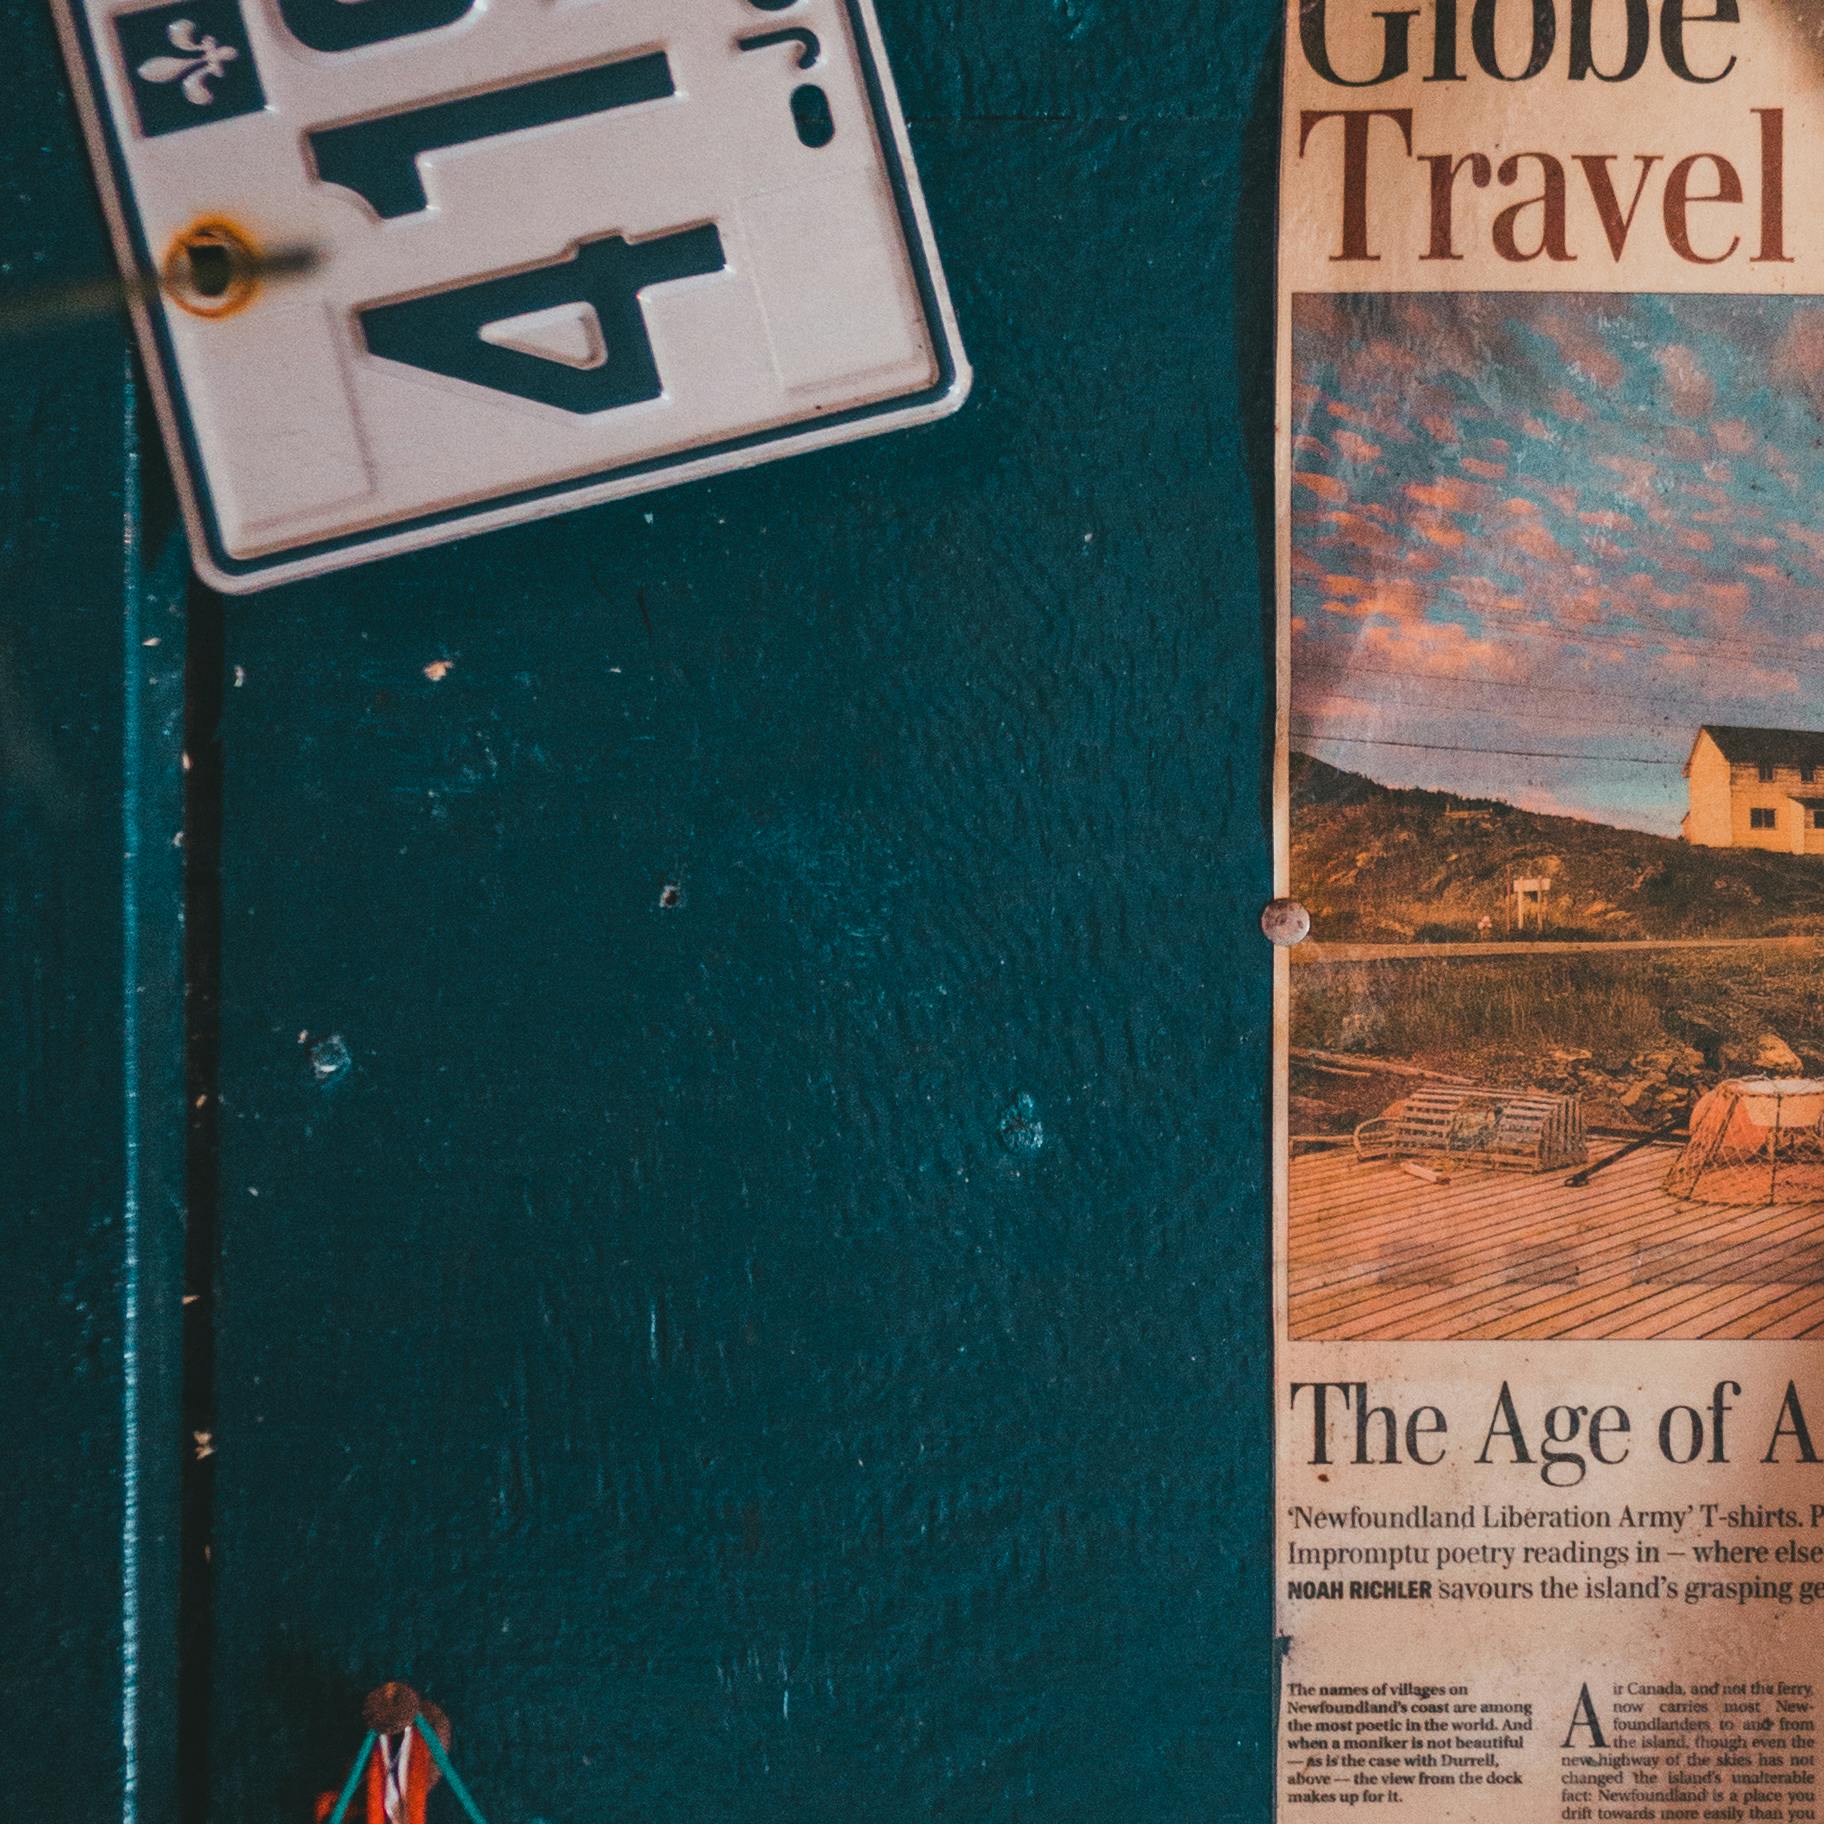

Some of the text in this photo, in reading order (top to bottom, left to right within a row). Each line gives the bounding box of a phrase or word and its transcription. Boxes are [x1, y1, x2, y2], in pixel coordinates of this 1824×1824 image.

[1298, 107, 1794, 265] Travel
[1290, 1380, 1449, 1466] The
[1474, 1380, 1632, 1487] Age
[1658, 1380, 1741, 1464] of
[1288, 1505, 1475, 1529] ‘Newfoundland
[1483, 1505, 1611, 1528] Liberation
[1619, 1505, 1693, 1533] Army’
[1700, 1504, 1803, 1528] T-shirts.
[1290, 1542, 1429, 1569] Impromptu
[1437, 1545, 1515, 1569] poetry
[1523, 1540, 1629, 1569] readings
[1636, 1540, 1660, 1563] in
[1692, 1537, 1769, 1563] where
[1288, 1581, 1344, 1600] NOAH
[1349, 1580, 1432, 1600] RICHLER
[1438, 1579, 1533, 1601] savours
[1540, 1576, 1578, 1599] the
[1586, 1576, 1678, 1599] island’s
[1685, 1576, 1793, 1605] grasping
[1288, 1683, 1316, 1696] The
[1319, 1686, 1369, 1696] names
[1371, 1683, 1388, 1696] of
[1449, 1686, 1468, 1695] on
[1411, 1702, 1449, 1714] coast
[1453, 1704, 1477, 1713] are
[1480, 1703, 1533, 1717] among
[1288, 1718, 1532, 1735] the most poetic in the world. And
[1287, 1735, 1523, 1750] when a moniker is not beautiful
[1306, 1756, 1323, 1769] as
[1326, 1754, 1339, 1767] is
[1341, 1754, 1366, 1767] the
[1368, 1757, 1401, 1767] case
[1404, 1754, 1437, 1767] with
[1441, 1753, 1499, 1768] Durrell,
[1288, 1772, 1331, 1785] above
[1354, 1772, 1378, 1785] the
[1381, 1772, 1416, 1785] view
[1418, 1771, 1455, 1785] from
[1459, 1771, 1483, 1784] the
[1486, 1771, 1523, 1784] dock
[1288, 1789, 1402, 1806] makes up for it.
